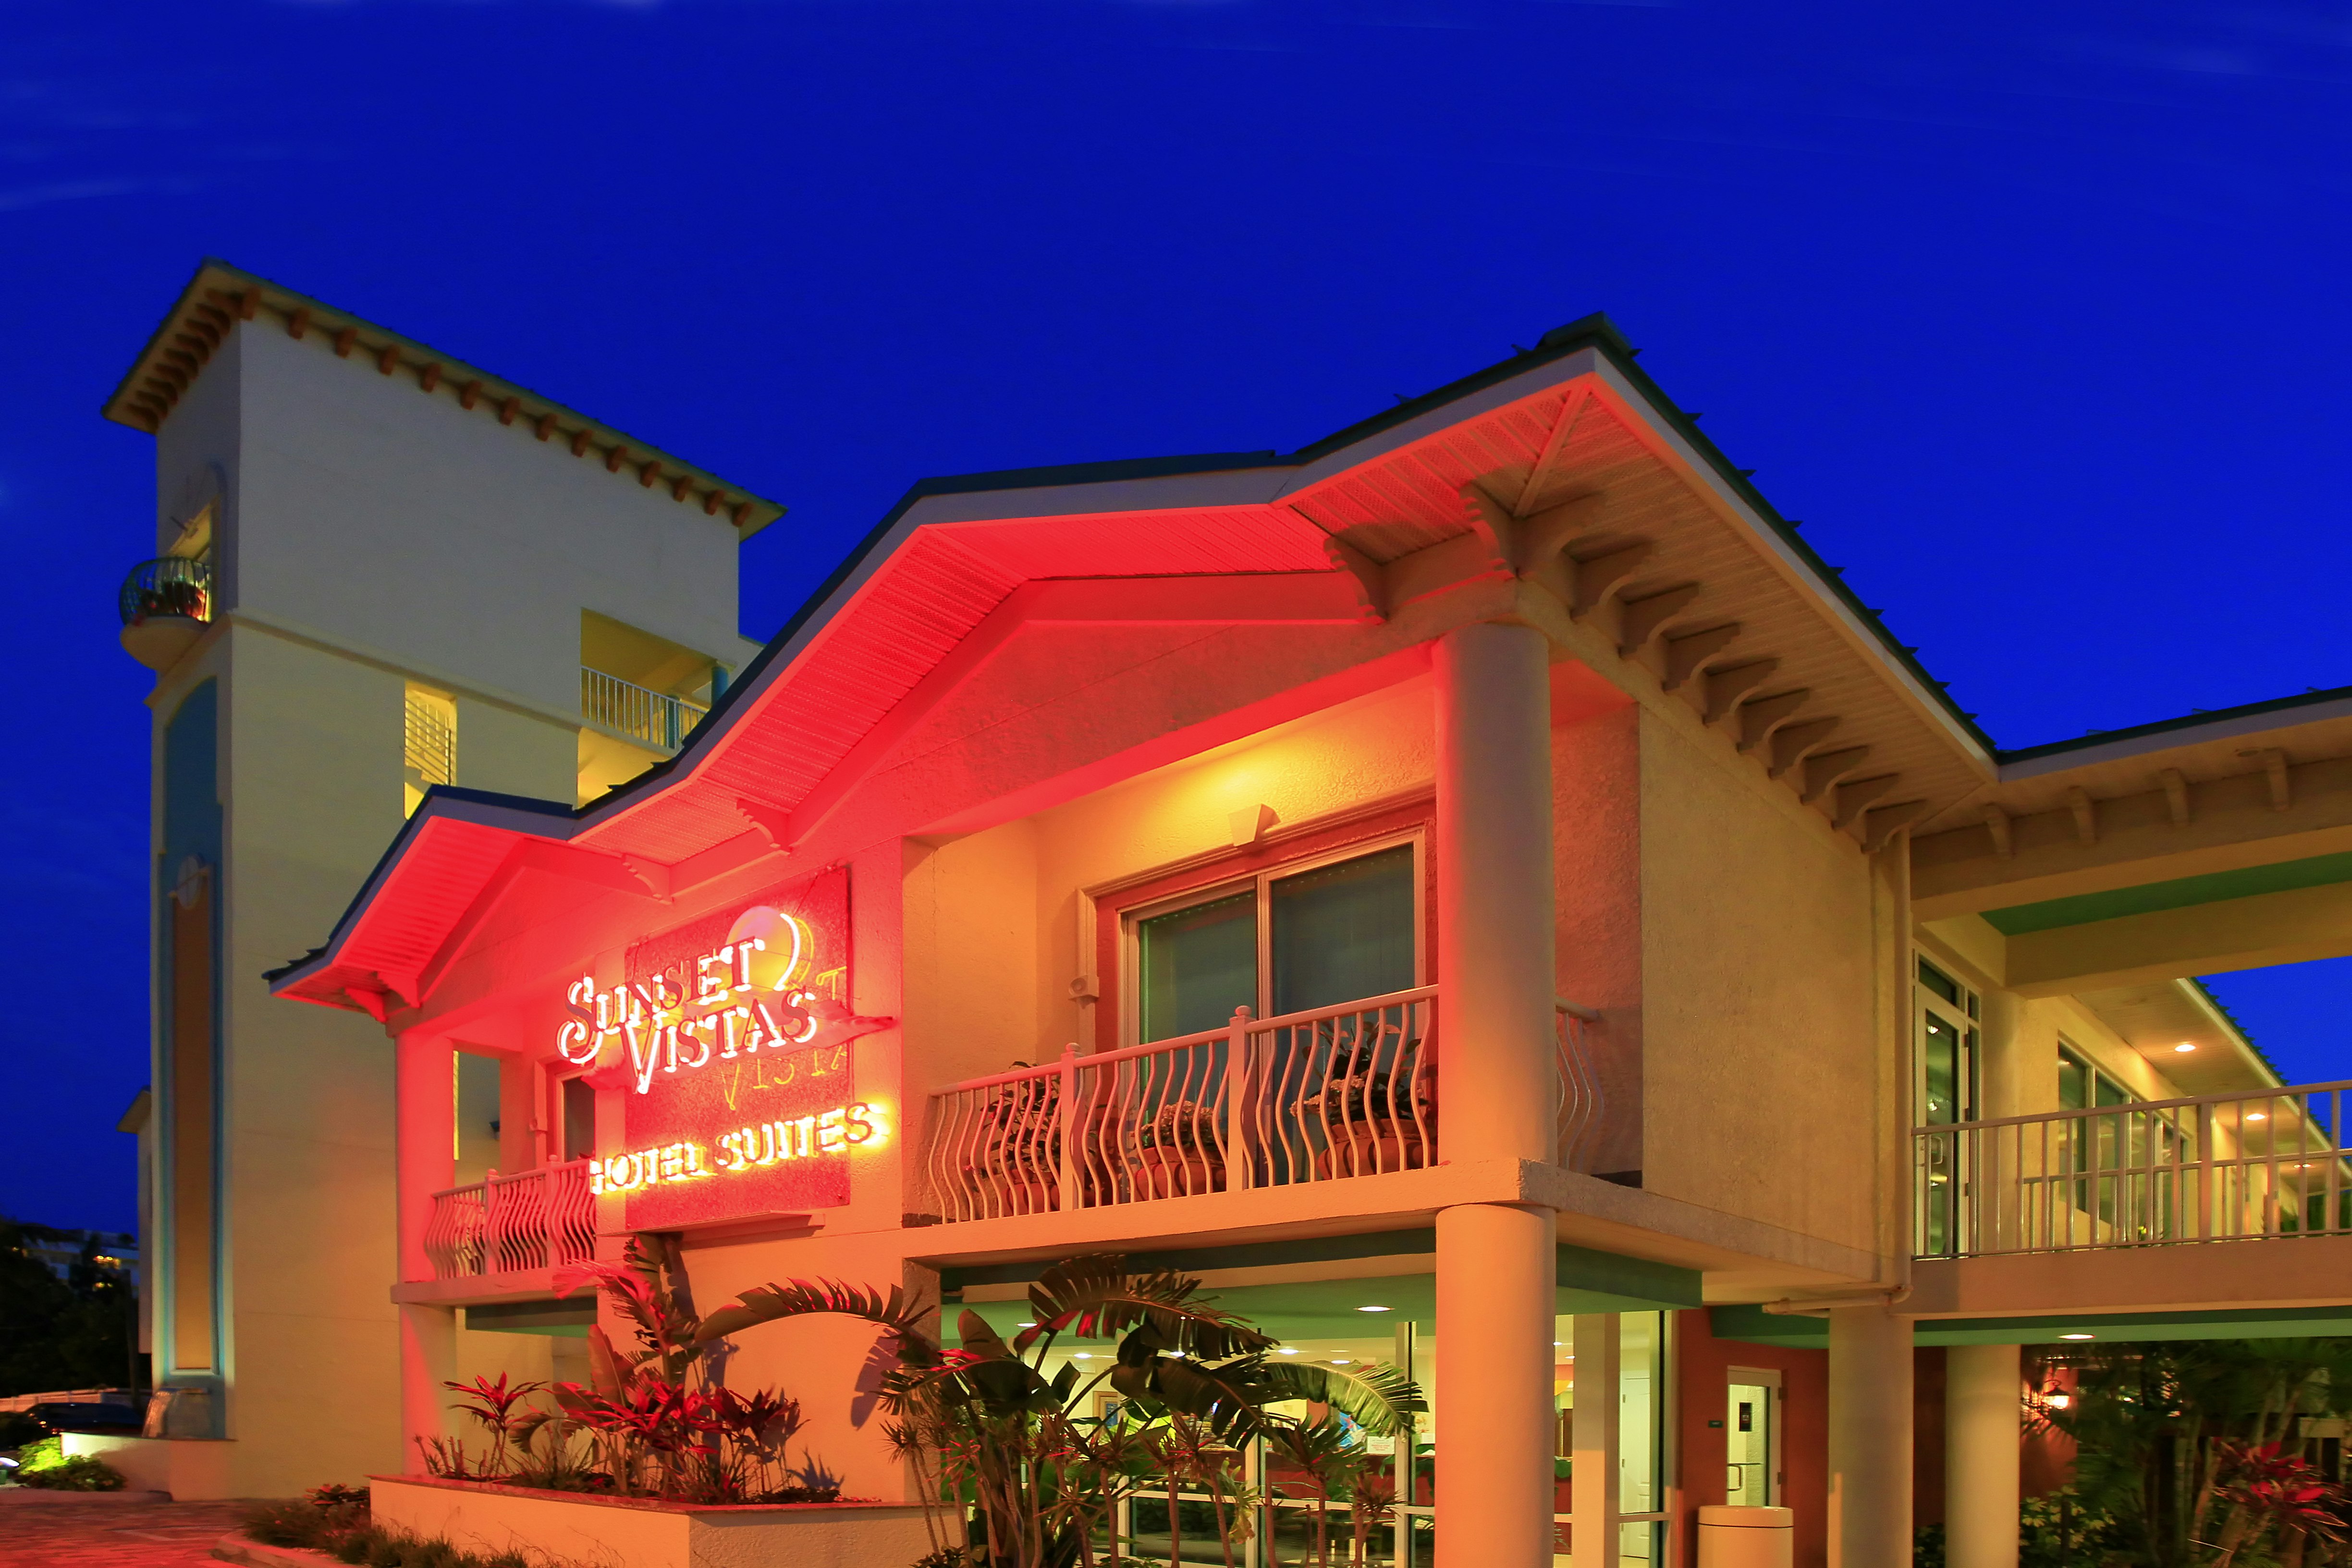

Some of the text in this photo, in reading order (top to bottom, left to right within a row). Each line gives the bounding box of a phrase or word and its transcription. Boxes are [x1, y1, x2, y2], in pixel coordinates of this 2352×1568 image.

[556, 936, 765, 1064] SUNSET
[615, 986, 816, 1094] VISTAS
[589, 1102, 885, 1195] HOTEL SUITES
